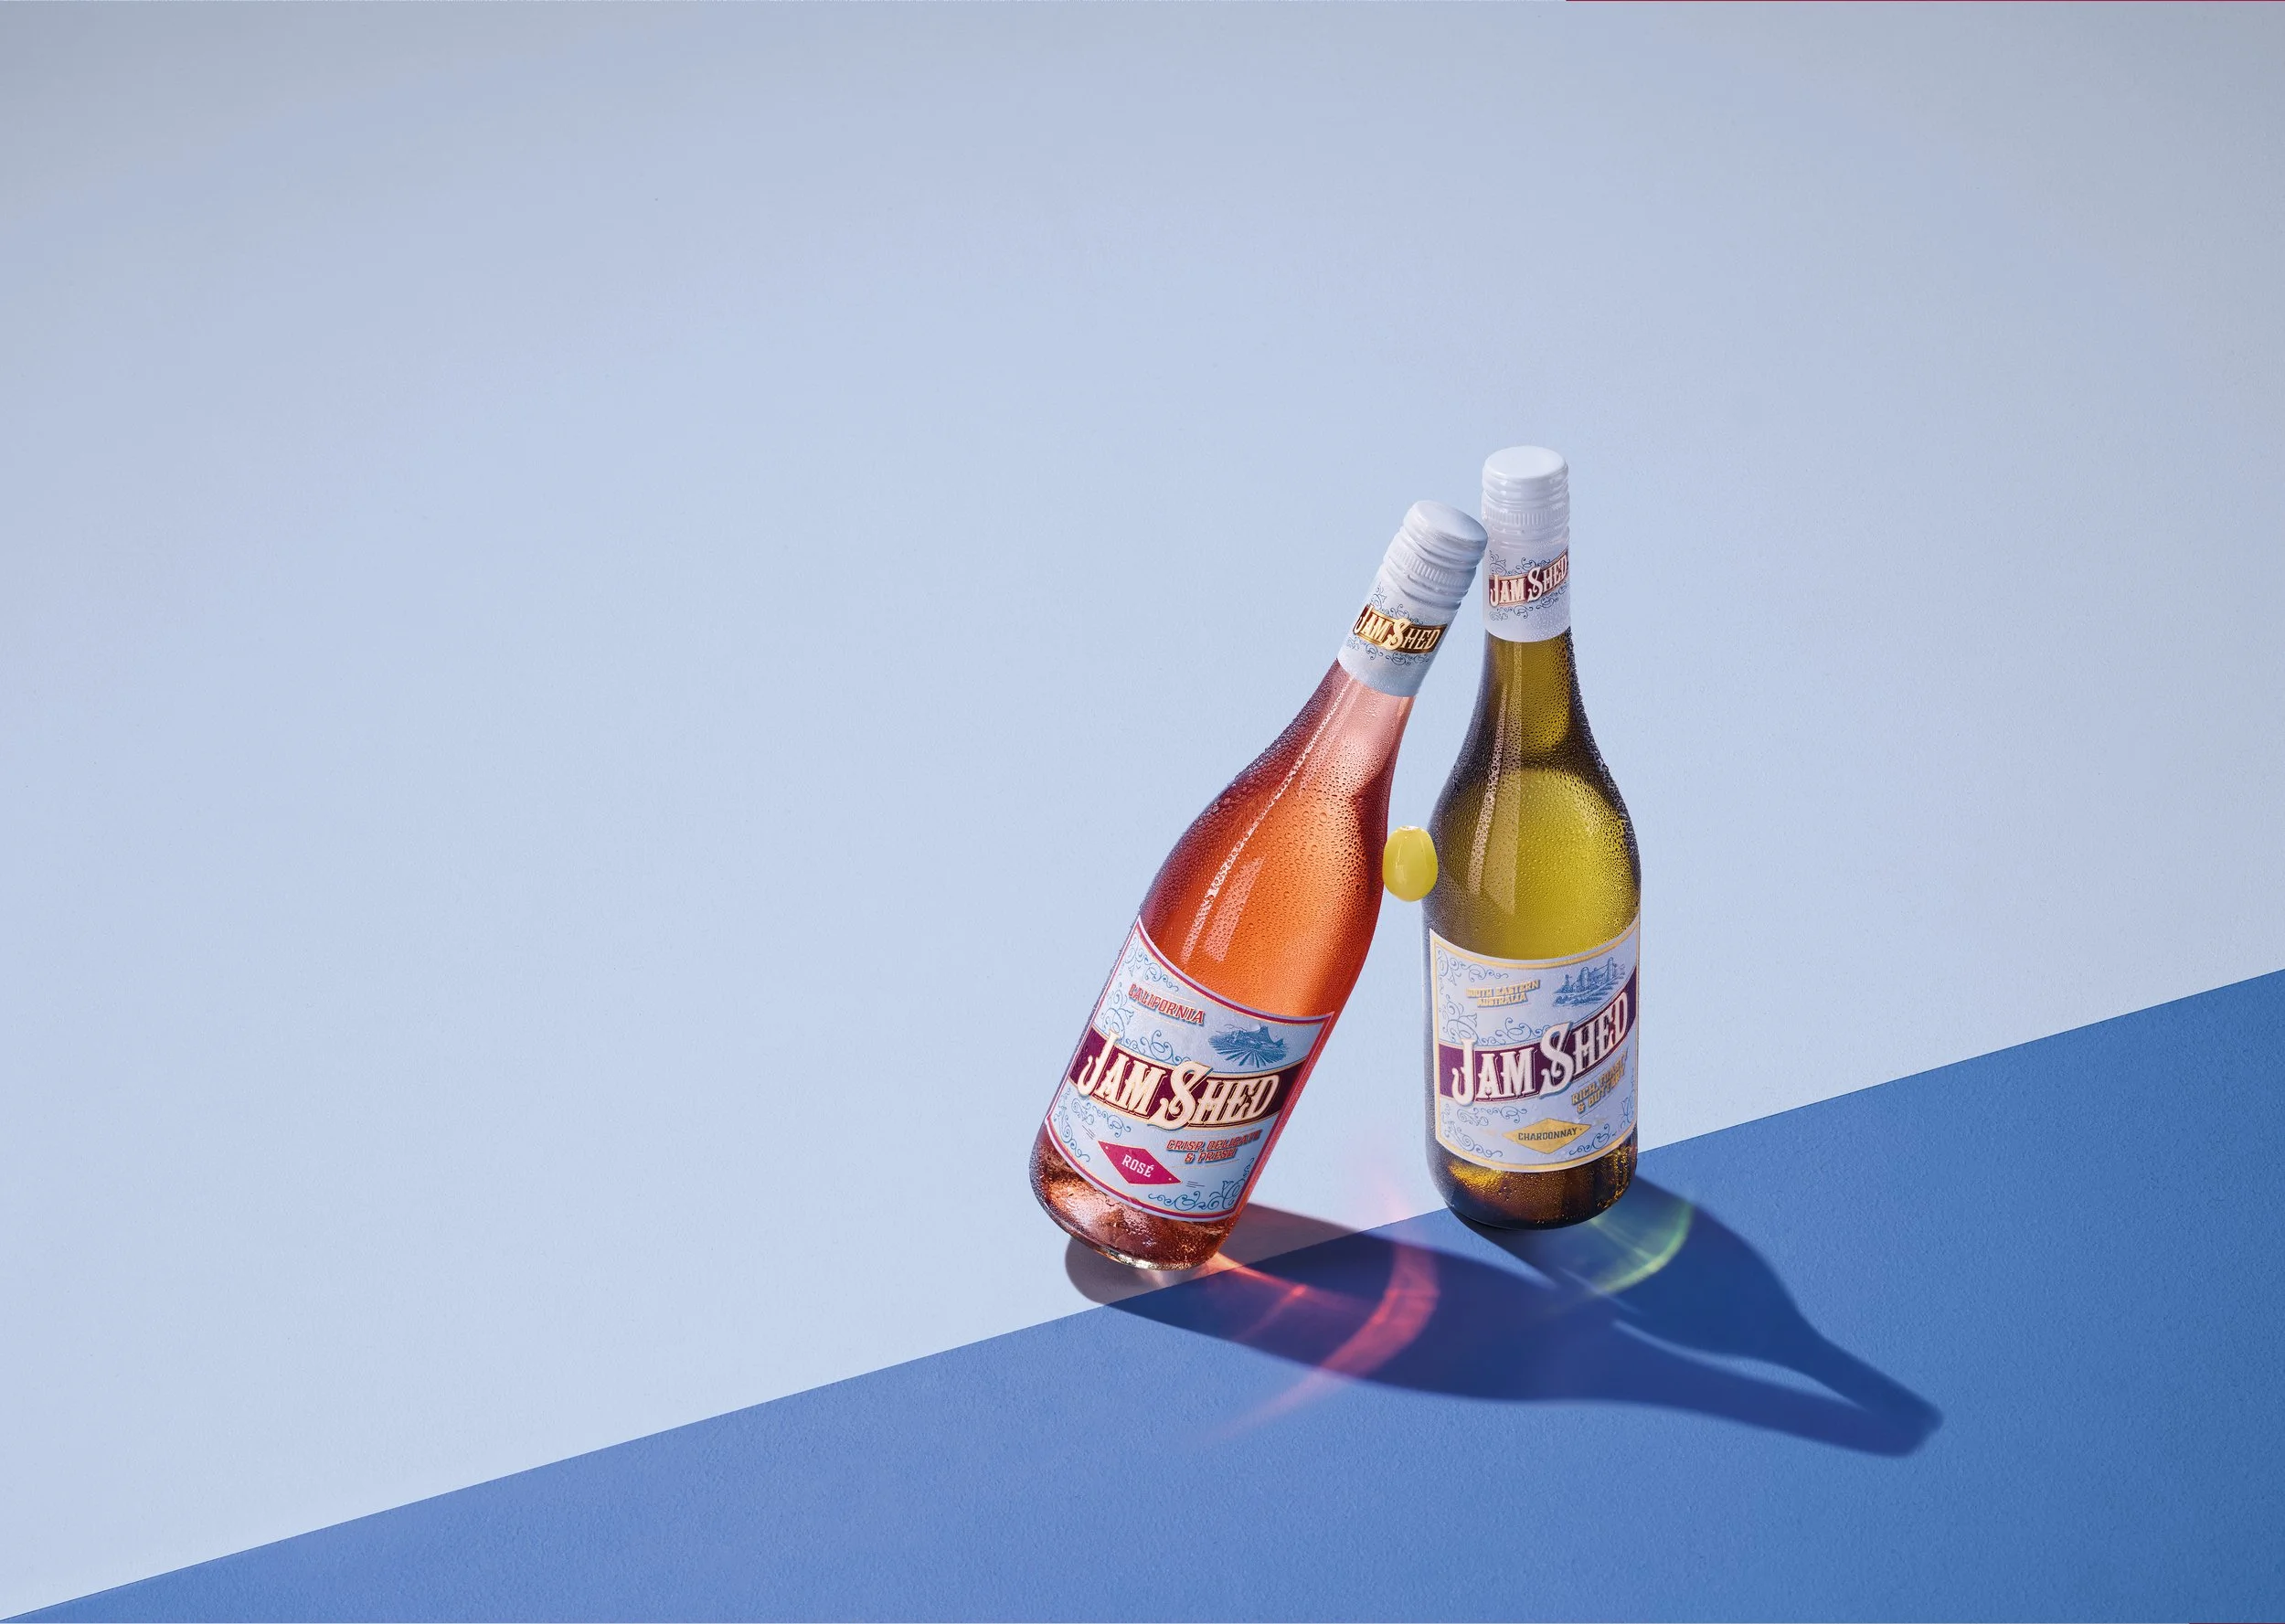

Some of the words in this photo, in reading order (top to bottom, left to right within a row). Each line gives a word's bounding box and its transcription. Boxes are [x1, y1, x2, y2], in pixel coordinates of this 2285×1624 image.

[1490, 573, 1525, 608] JAM
[1527, 552, 1568, 602] SHED
[1385, 618, 1440, 650] SHED
[1128, 983, 1206, 1025] CALIFORNIA
[1451, 1037, 1537, 1107] JAM
[1539, 990, 1629, 1099] SHED
[1077, 1030, 1167, 1115] JAM
[1148, 1061, 1281, 1130] SHED
[1578, 1102, 1586, 1114] &
[1166, 1140, 1206, 1152] CRISP,
[1518, 1127, 1578, 1141] CHARDONNAY
[1121, 1154, 1155, 1179] ROSÉ
[1185, 1152, 1196, 1163] &
